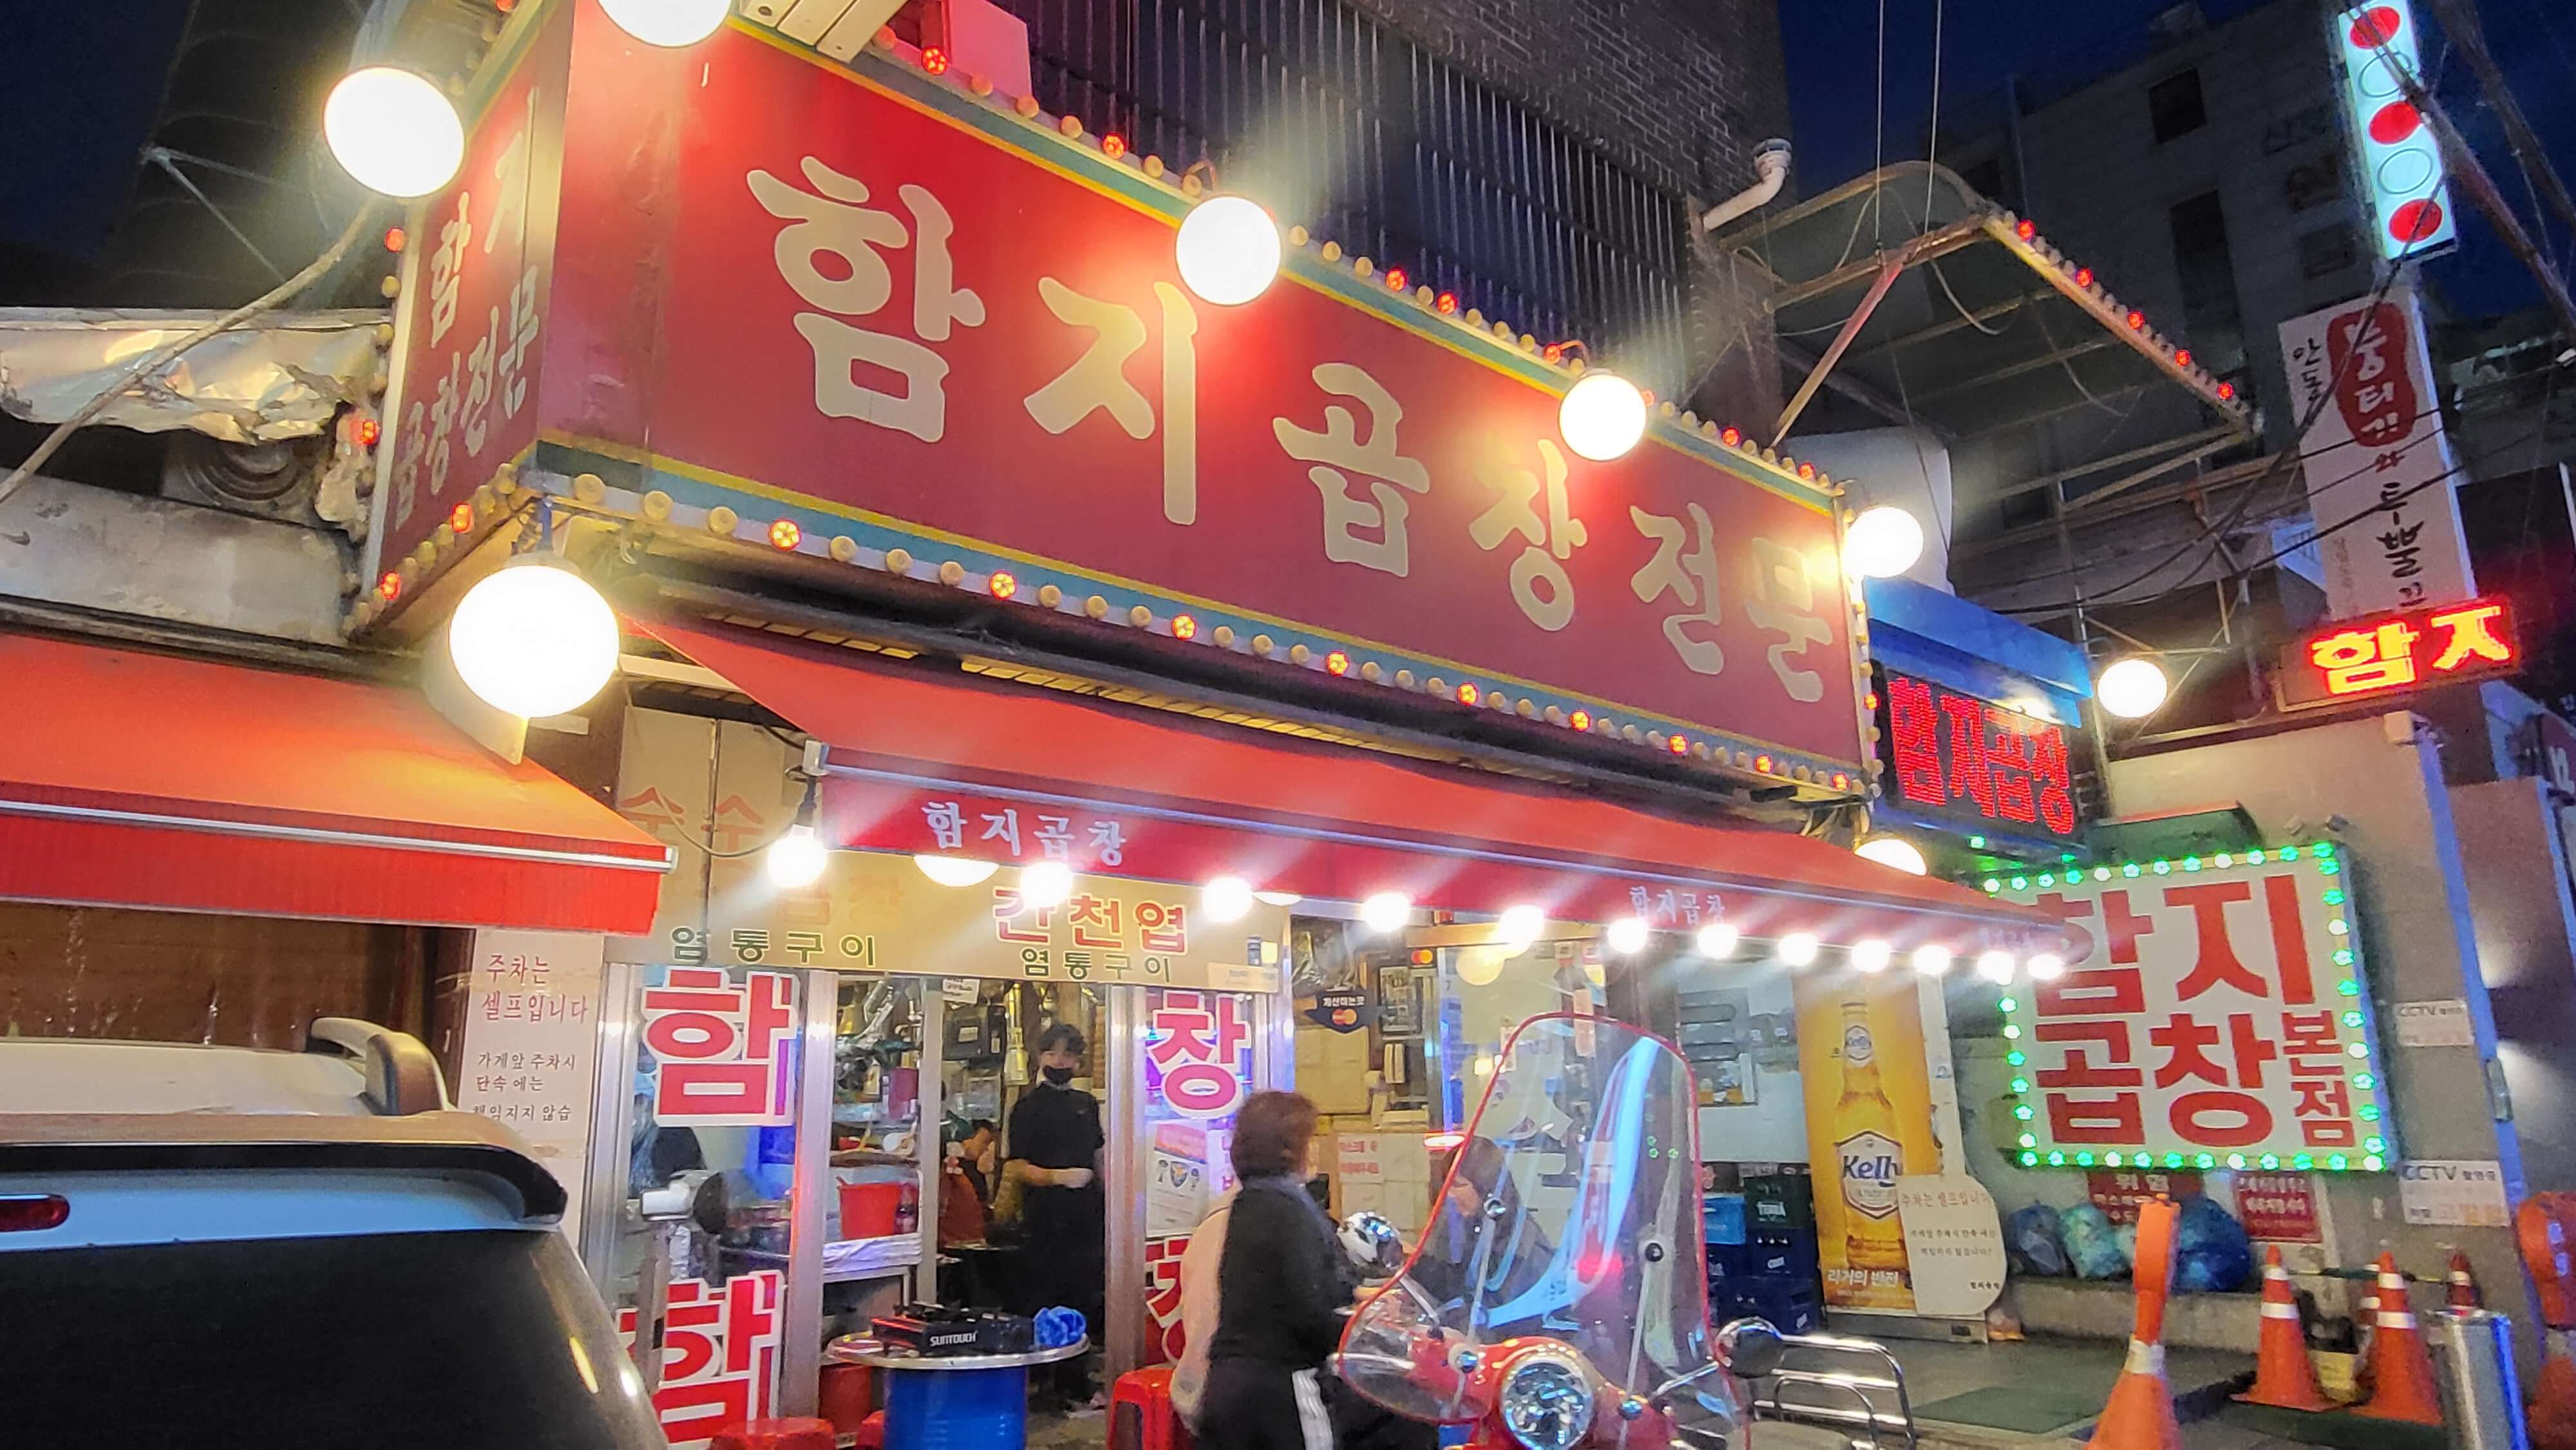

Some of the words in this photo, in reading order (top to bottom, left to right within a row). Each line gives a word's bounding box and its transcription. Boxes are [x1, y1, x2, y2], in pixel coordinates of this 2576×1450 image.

[1888, 677, 2074, 835] 함지곱창
[921, 801, 1128, 867] 함지곱창
[486, 954, 551, 986] 주차는
[1020, 947, 1171, 984] 염통구이
[482, 990, 589, 1024] 셀프입니다
[477, 1051, 526, 1070] 가게앞
[530, 1053, 576, 1071] 주차시
[645, 968, 792, 1116] 함
[1149, 992, 1247, 1111] 창
[2034, 1012, 2278, 1148] 곱창
[2280, 1009, 2356, 1148] 본점
[2401, 1164, 2458, 1182] CCTV
[929, 1330, 979, 1348] SUNTOUCH
